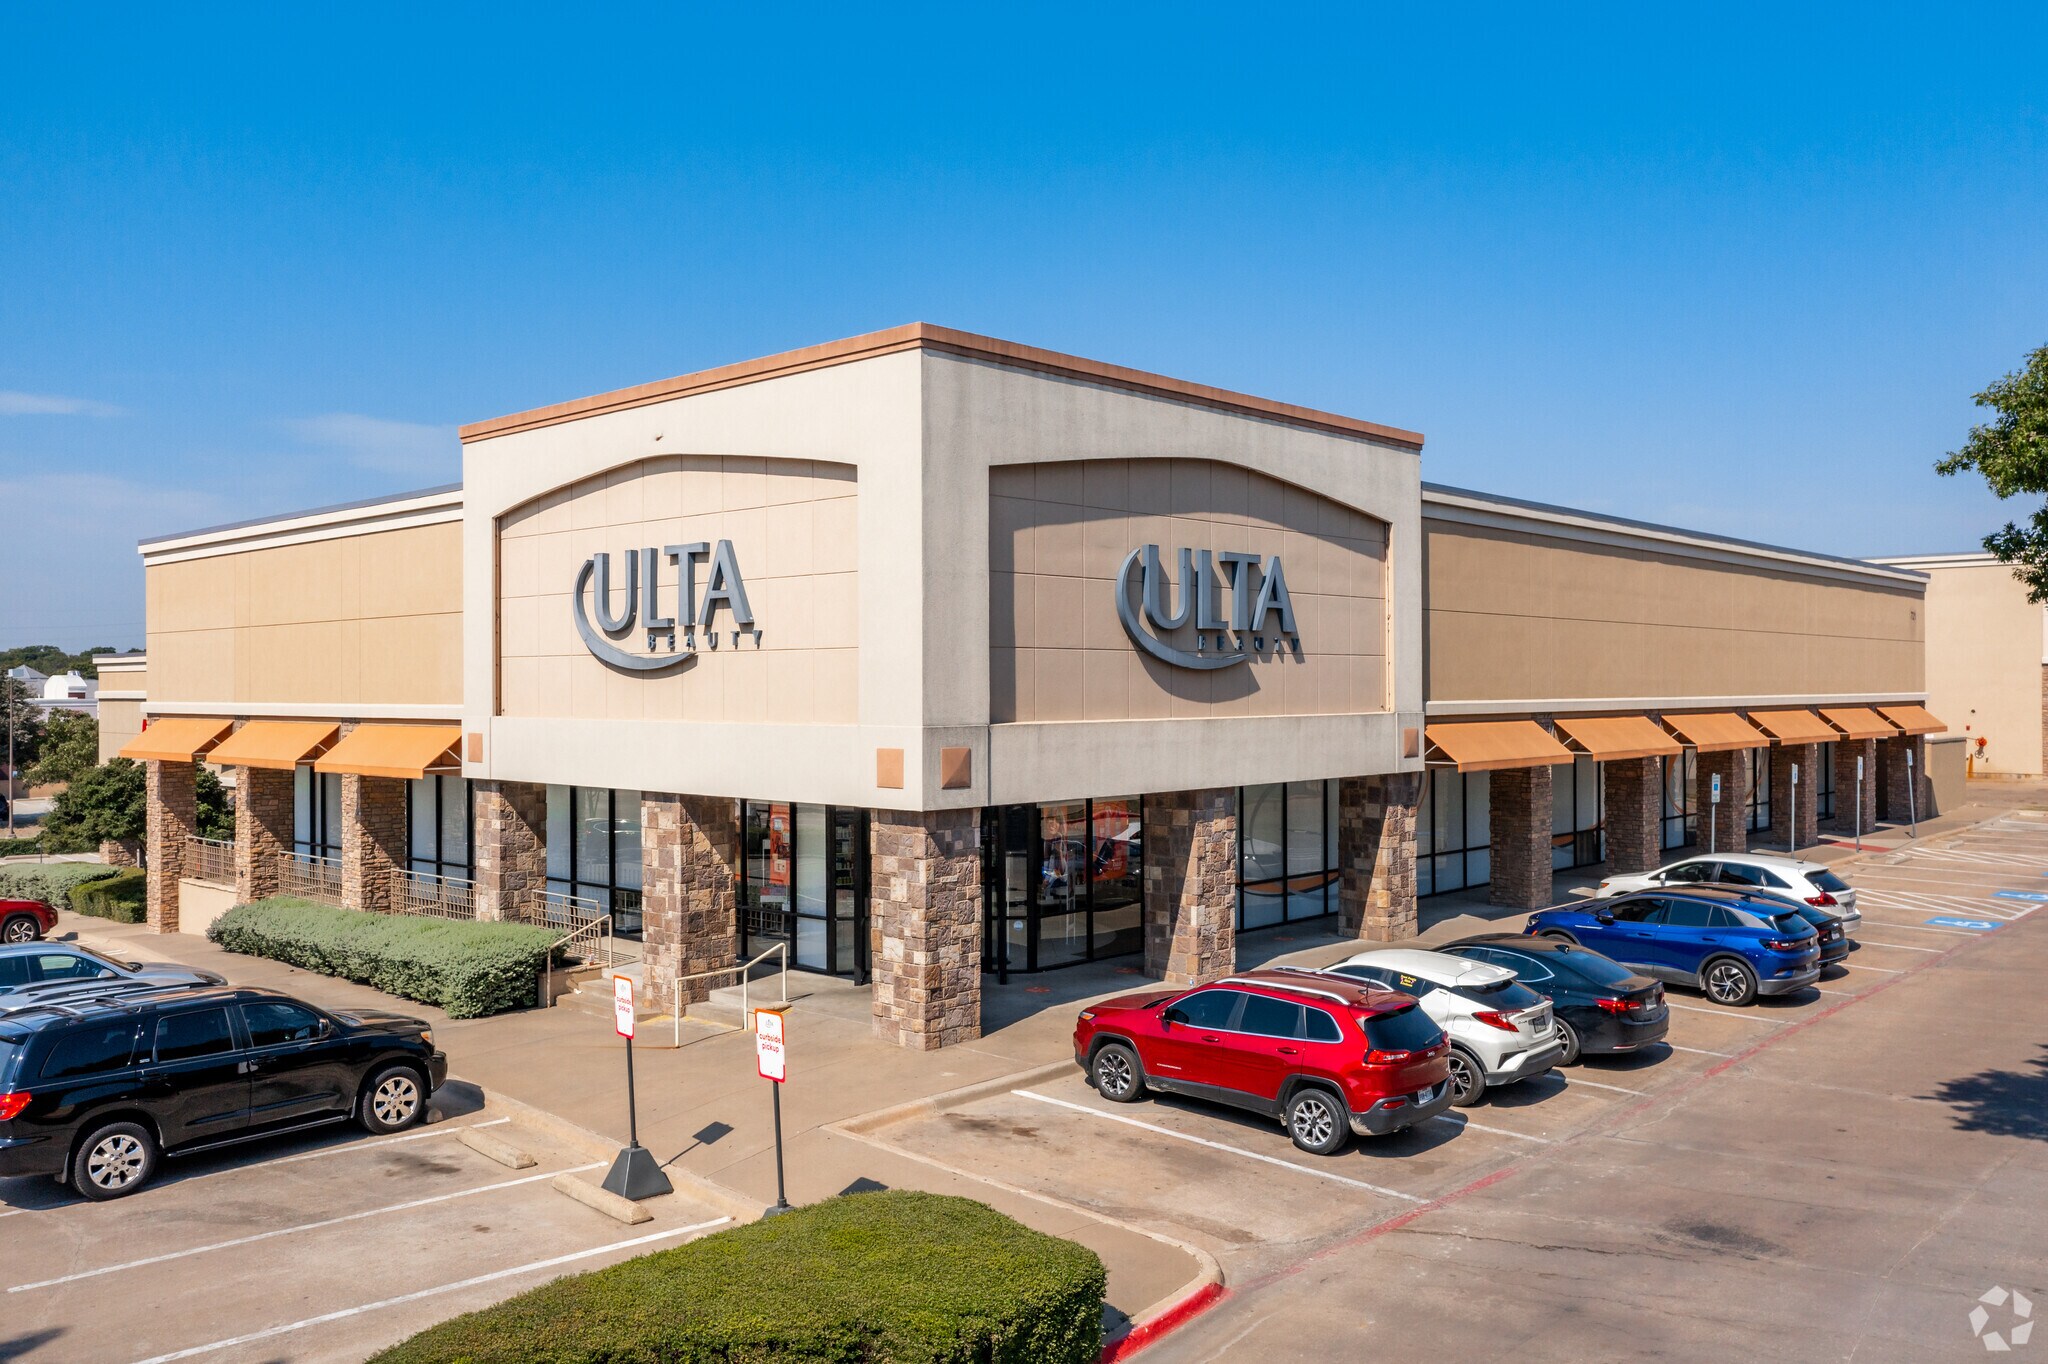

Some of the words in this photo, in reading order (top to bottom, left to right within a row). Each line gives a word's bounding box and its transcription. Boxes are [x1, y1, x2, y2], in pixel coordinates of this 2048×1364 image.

[593, 539, 755, 632] ULTA
[1142, 544, 1297, 633] ULTA
[647, 630, 763, 652] BEAUTY
[1197, 634, 1300, 653] BEAUTY
[759, 1033, 781, 1043] curbside
[761, 1043, 779, 1053] pickup
